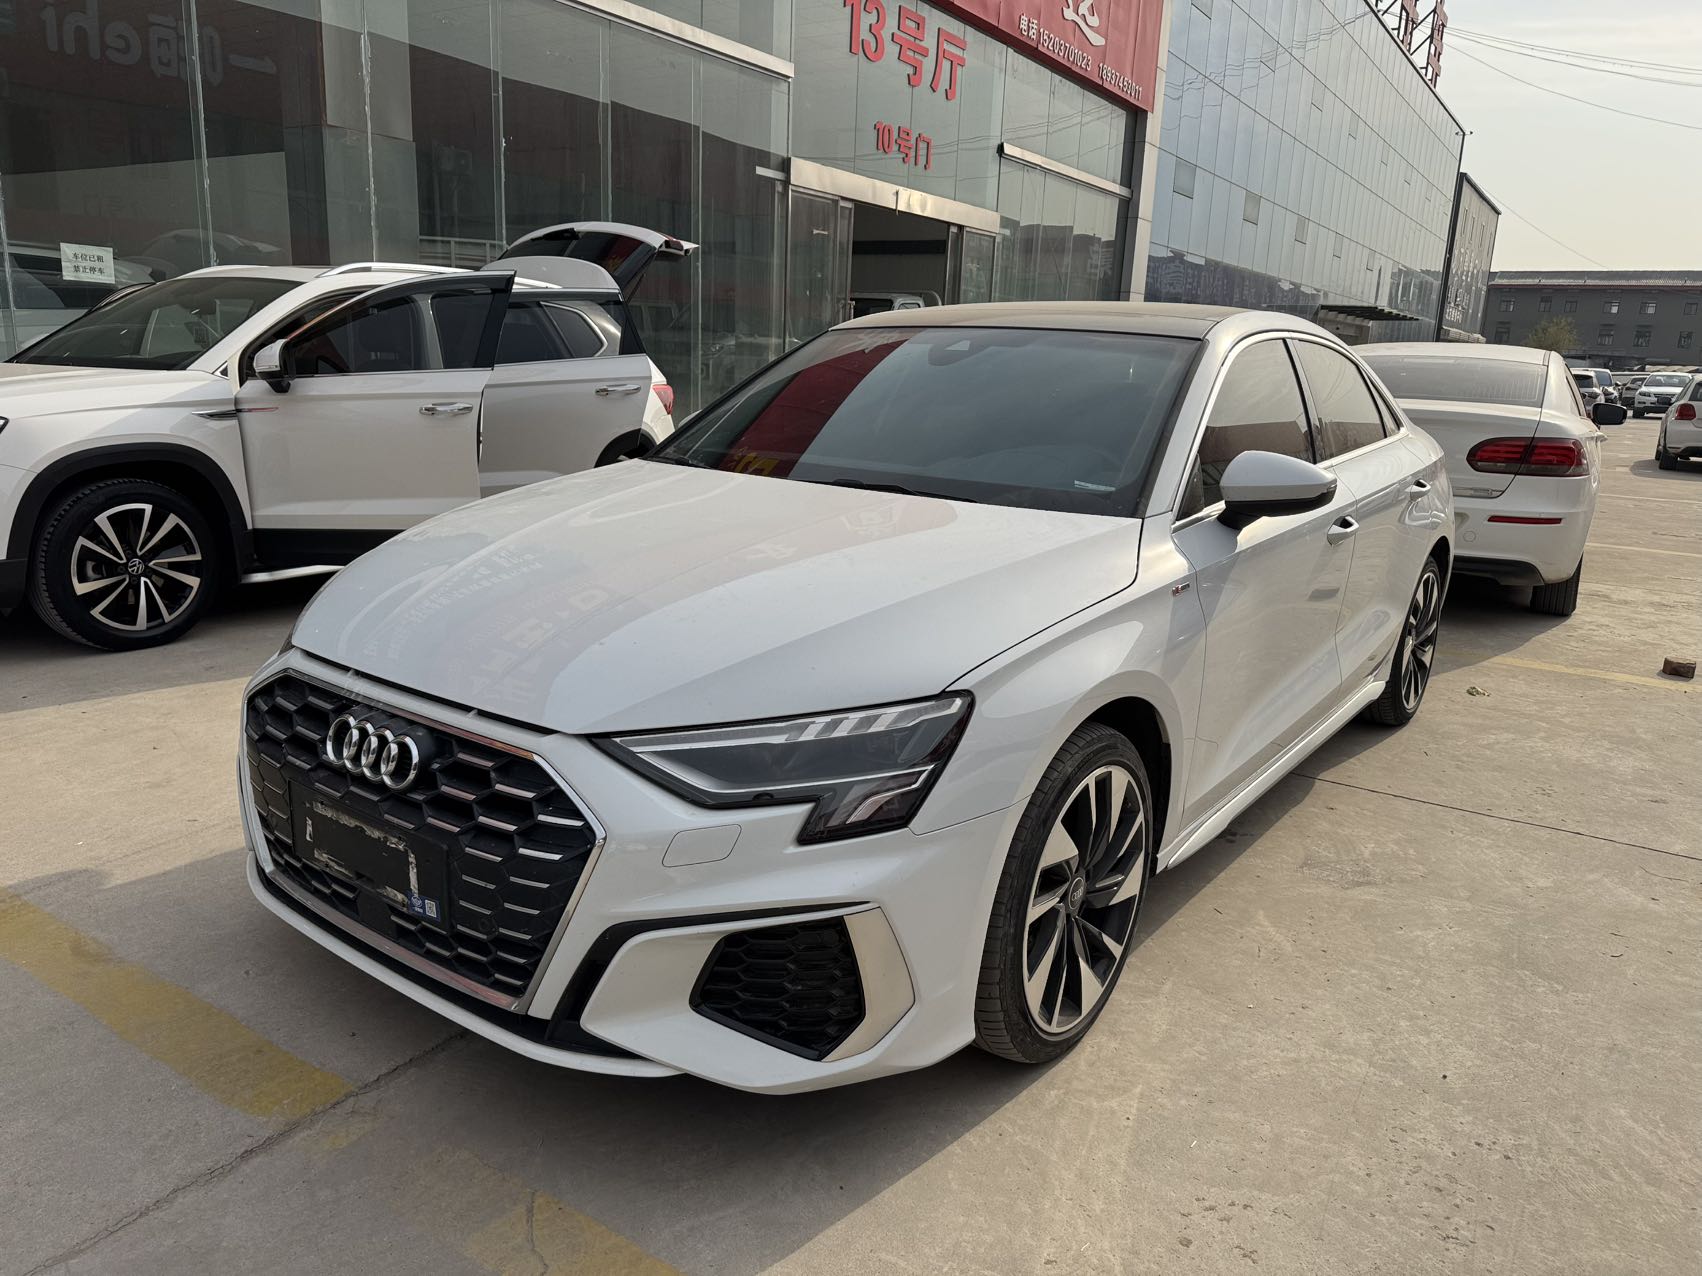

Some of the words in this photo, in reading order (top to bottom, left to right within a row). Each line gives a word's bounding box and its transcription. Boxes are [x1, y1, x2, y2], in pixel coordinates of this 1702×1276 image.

[843, 0, 967, 101] 13号厅
[1019, 13, 1038, 41] 电话
[1039, 28, 1092, 71] 15203701023
[874, 120, 933, 171] 10号门
[72, 252, 104, 263] 车位已租
[73, 264, 105, 276] 禁止停车
